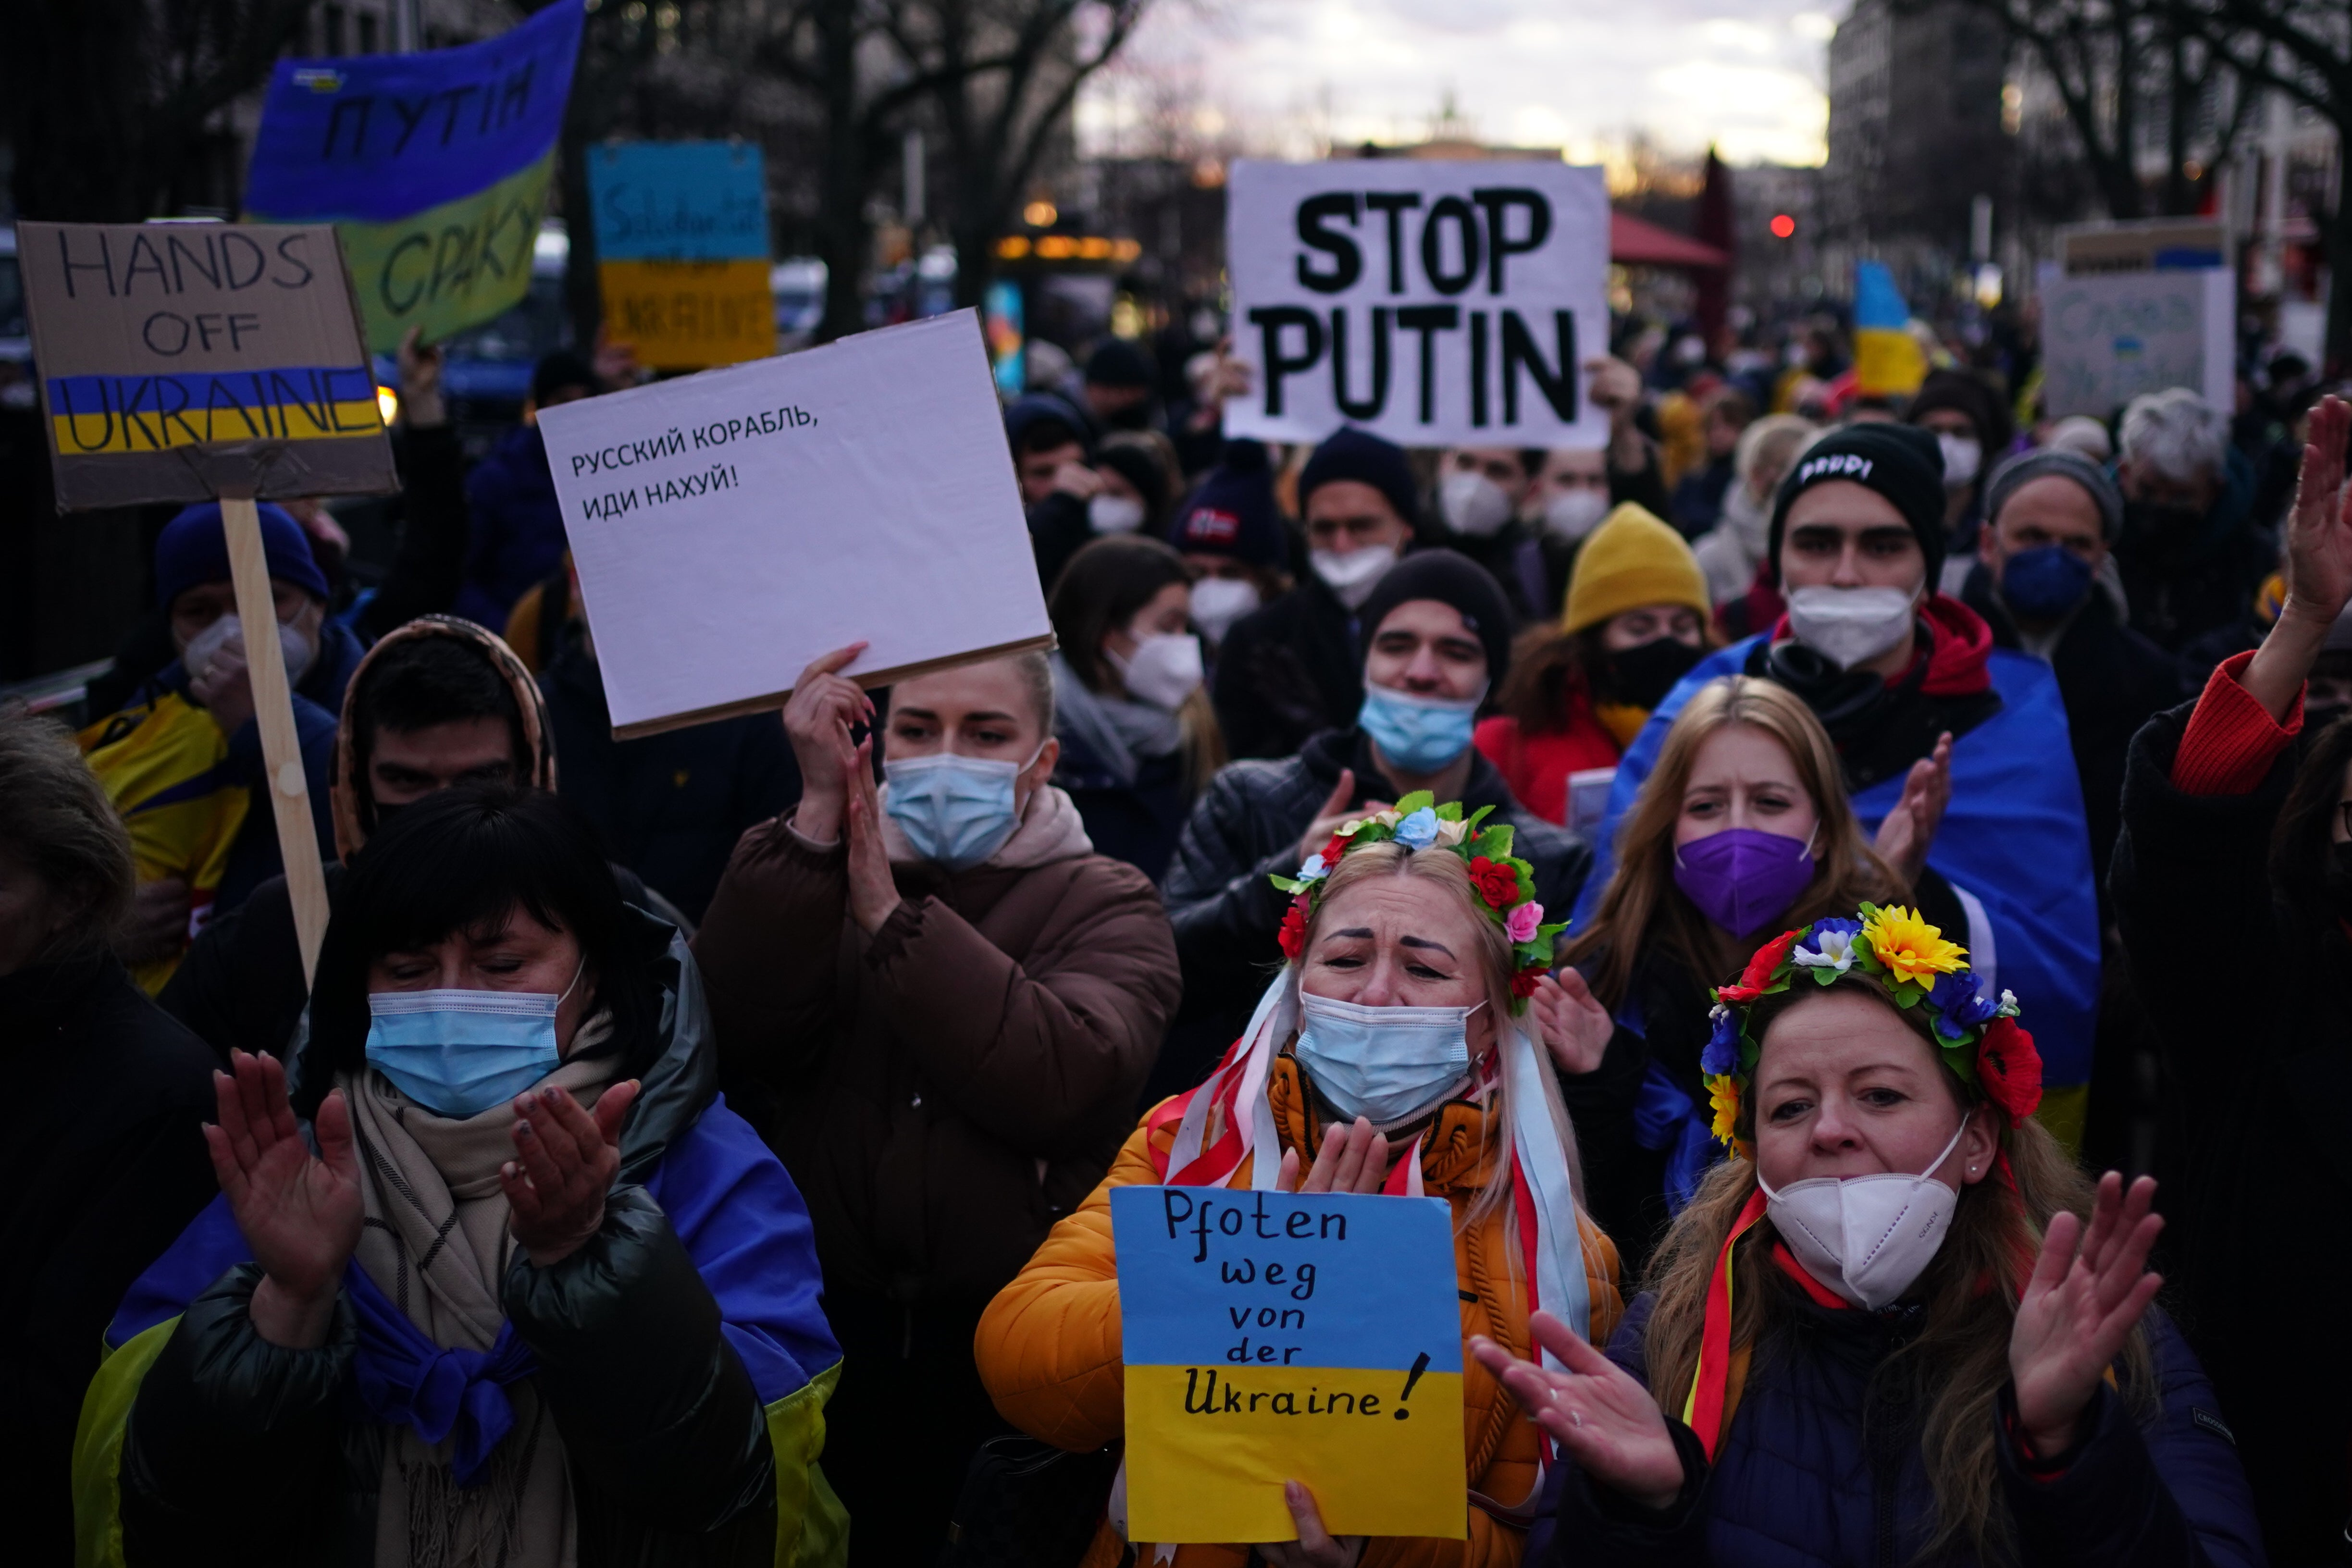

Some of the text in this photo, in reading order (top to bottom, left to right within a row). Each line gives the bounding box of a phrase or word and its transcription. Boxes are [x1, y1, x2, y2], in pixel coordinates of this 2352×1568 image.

[58, 229, 313, 298] HANDS
[1296, 187, 1551, 295] STOP
[143, 311, 260, 356] OFF
[1247, 305, 1579, 428] PUTIN
[61, 368, 379, 451] UKRAINE
[572, 406, 818, 477] РУССКИЙ КОРАБЛЬ,
[582, 463, 739, 521] ИДИ НАХУЙ!
[1164, 1189, 1347, 1263] Pfoten
[1222, 1258, 1316, 1300] weg
[1227, 1337, 1302, 1364] der
[1229, 1307, 1305, 1329] von
[1185, 1352, 1431, 1420] Ukraine!
